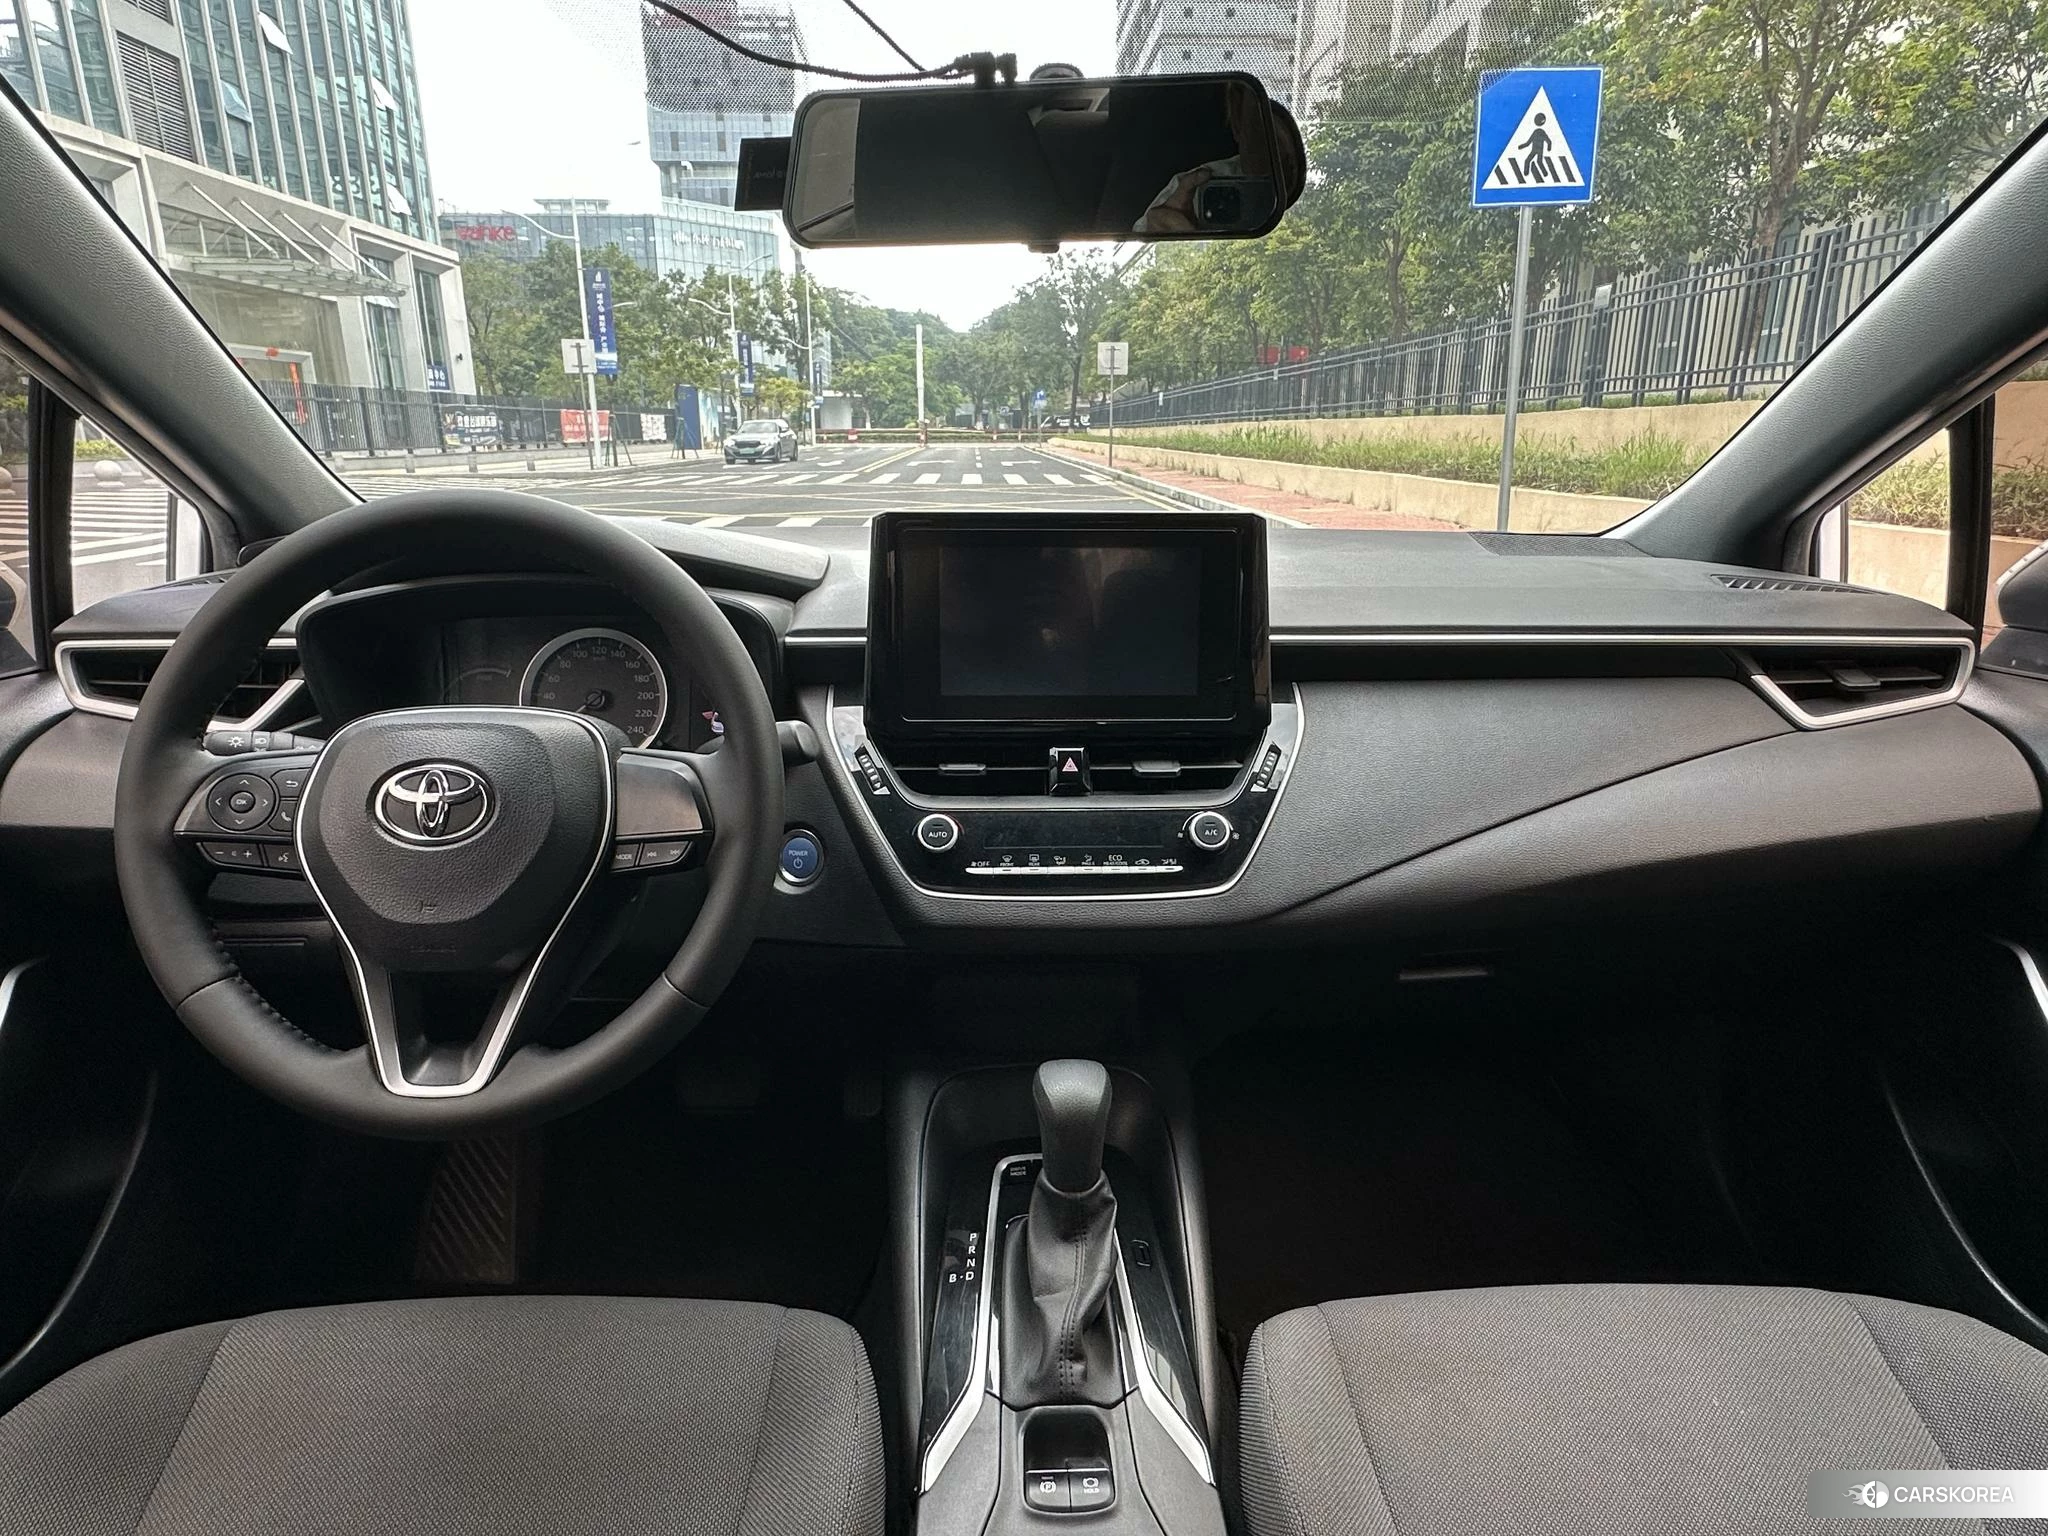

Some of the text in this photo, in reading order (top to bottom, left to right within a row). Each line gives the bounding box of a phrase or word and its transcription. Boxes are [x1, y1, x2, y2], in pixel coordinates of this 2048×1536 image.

[573, 650, 588, 658] 100
[592, 646, 607, 654] 120
[610, 650, 625, 658] 140
[560, 660, 571, 669] 80
[625, 661, 640, 669] 160
[543, 692, 555, 700] 40
[638, 692, 654, 700] 200
[635, 710, 652, 718] 220
[627, 726, 644, 734] 240
[970, 1233, 977, 1241] P
[968, 1245, 976, 1254] R
[967, 1259, 976, 1267] N
[949, 1271, 974, 1283] B D
